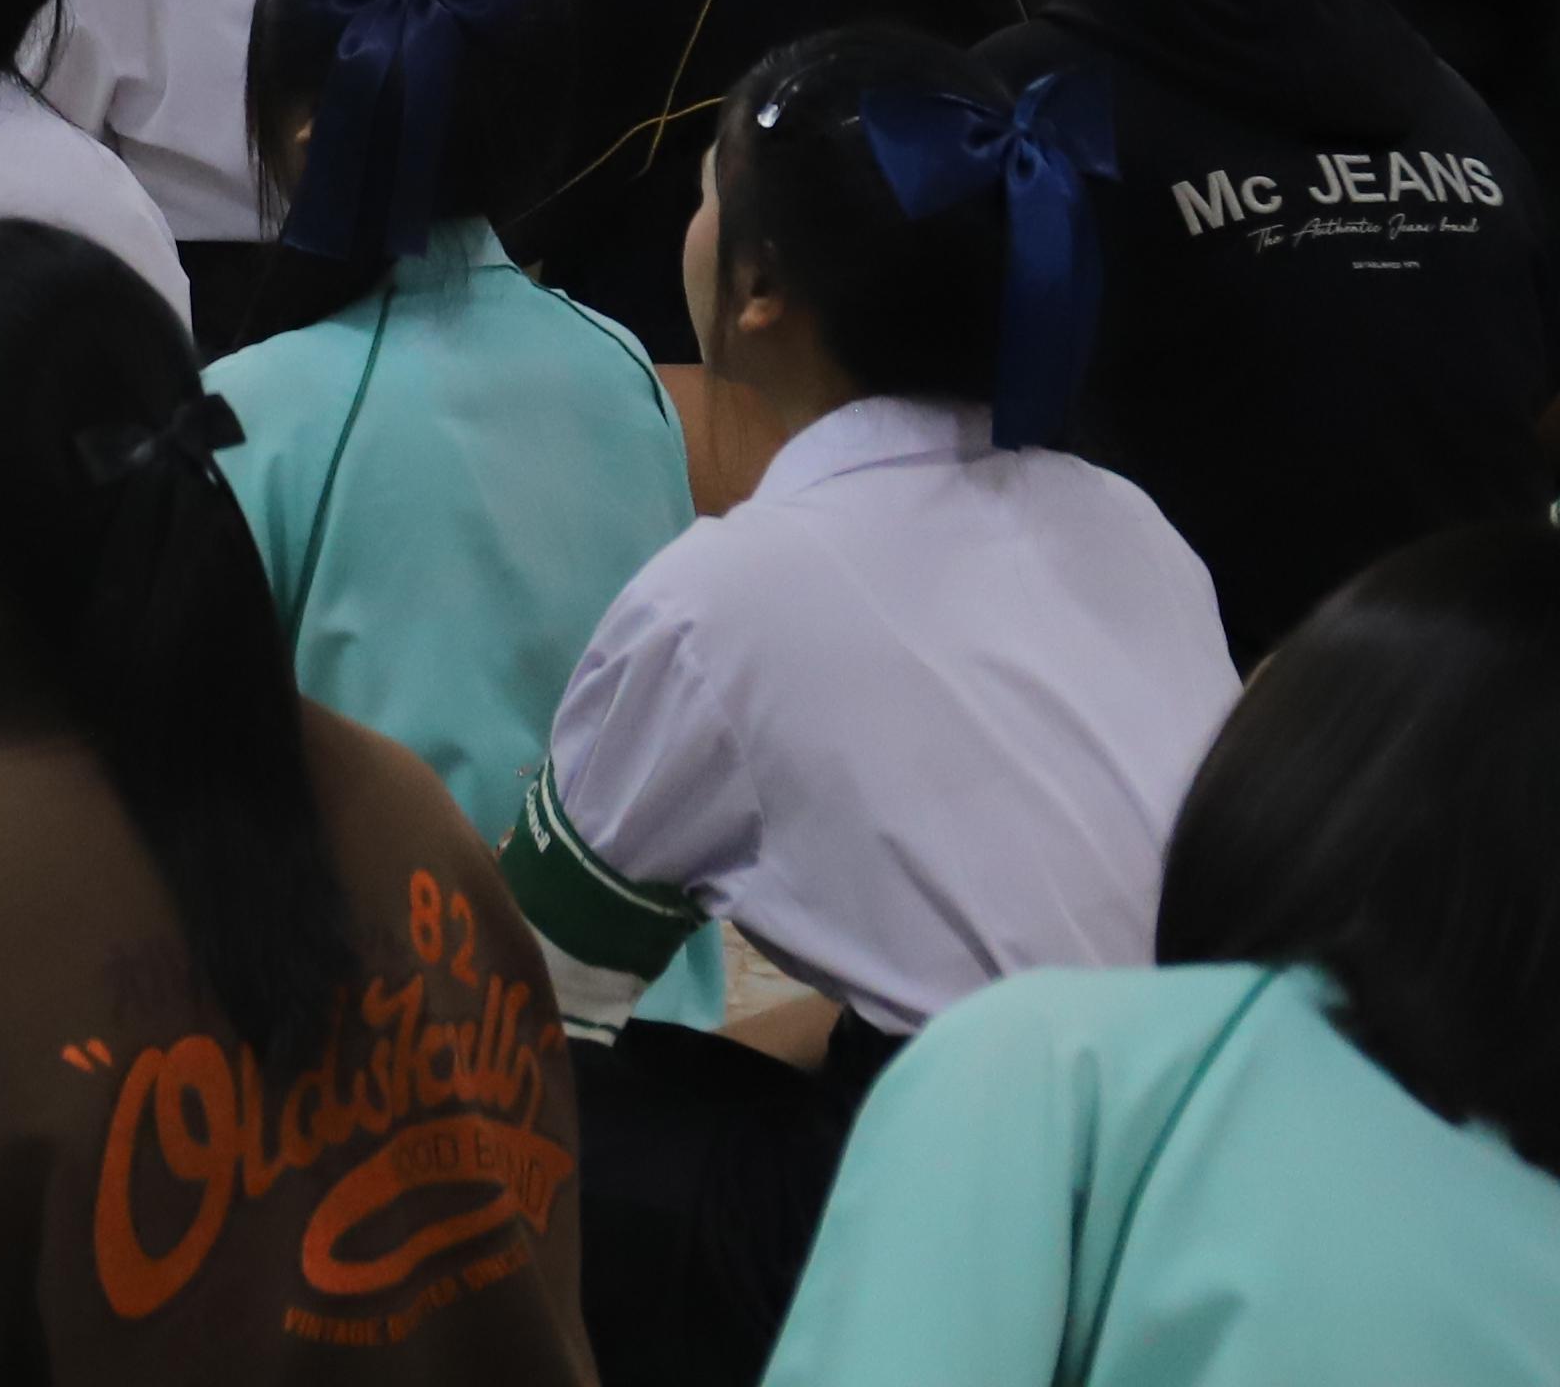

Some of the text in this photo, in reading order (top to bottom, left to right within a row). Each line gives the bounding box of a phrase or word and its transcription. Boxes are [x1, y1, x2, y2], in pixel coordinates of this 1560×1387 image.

[1171, 151, 1505, 237] Mc JEANS
[1248, 213, 1481, 256] The Authentic Jeans brand
[410, 868, 480, 989] 82
